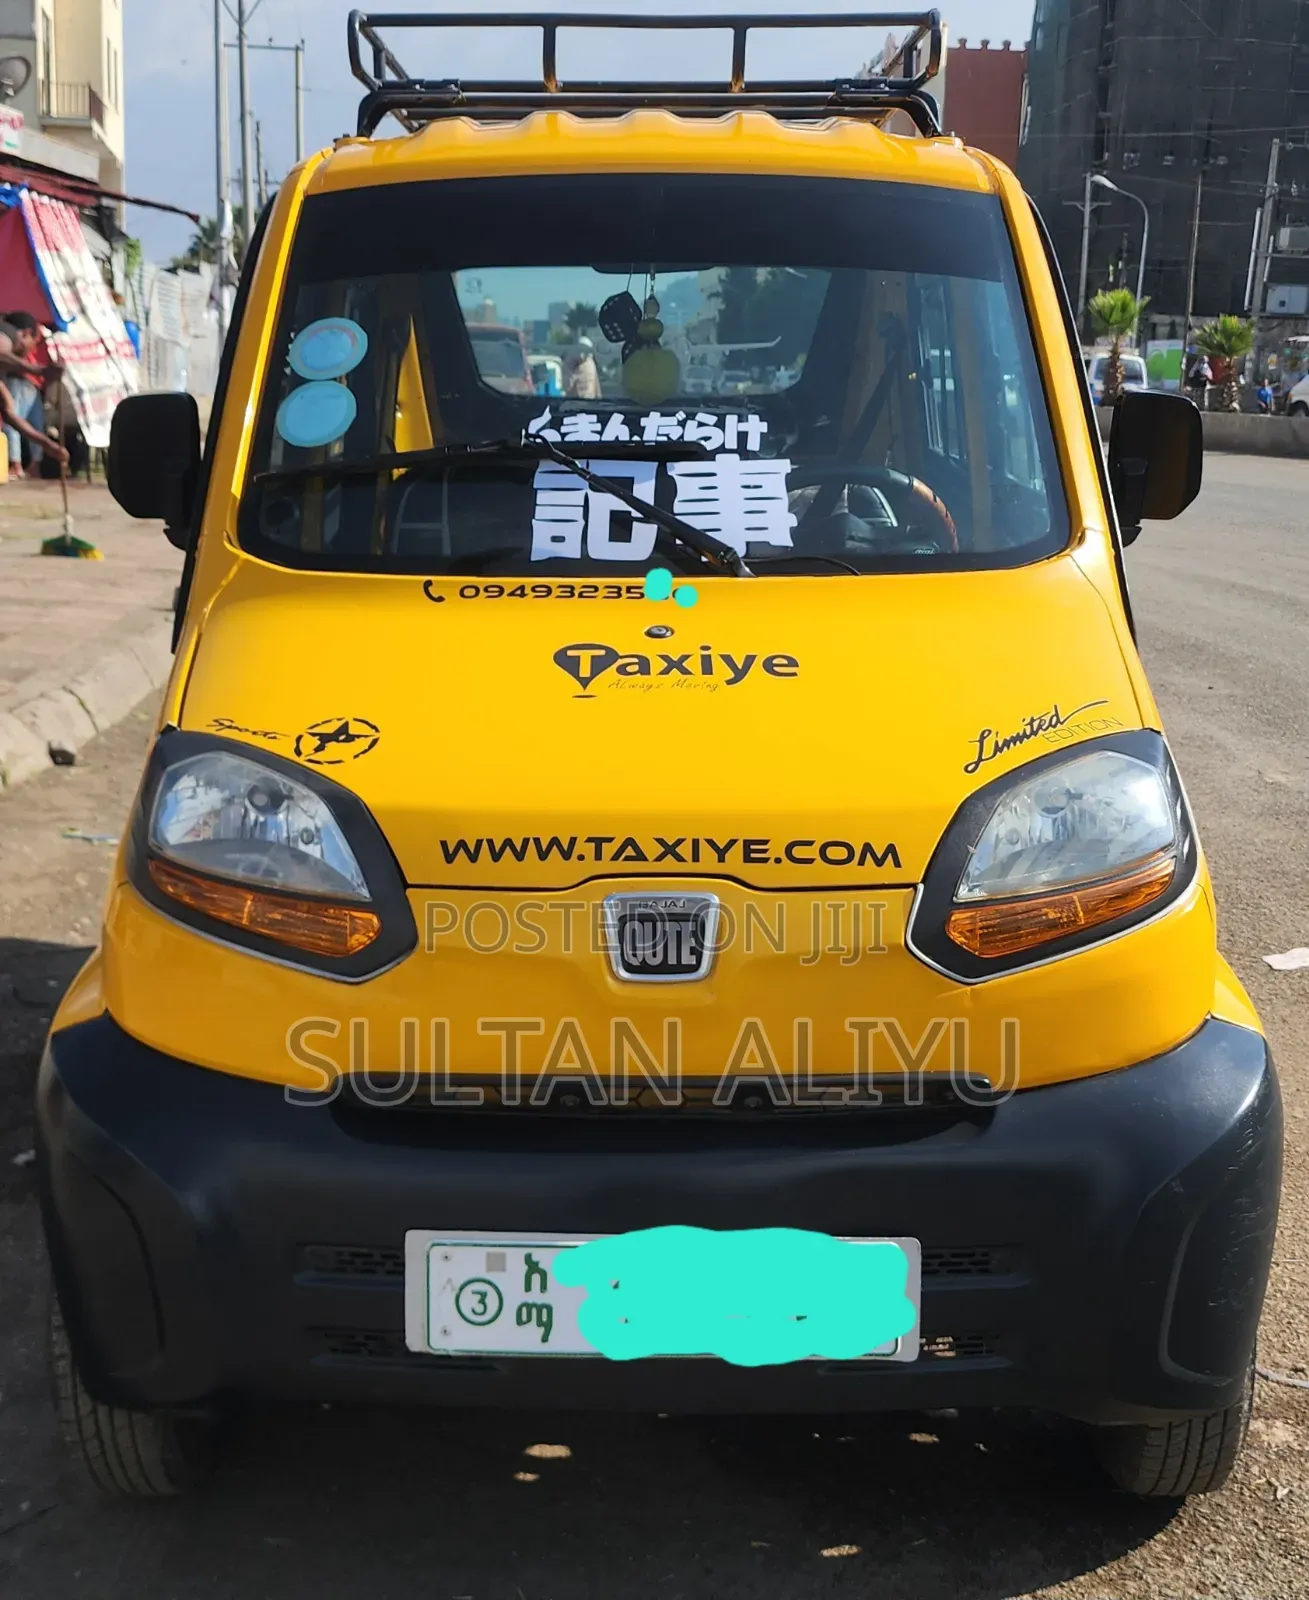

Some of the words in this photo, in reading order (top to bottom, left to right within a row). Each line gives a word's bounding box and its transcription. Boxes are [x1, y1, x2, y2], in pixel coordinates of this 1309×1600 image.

[530, 453, 798, 562] 記事
[458, 584, 697, 602] 09493235
[554, 643, 800, 688] Taxiye
[963, 700, 1109, 774] Limited
[1041, 716, 1124, 744] EDITION
[439, 836, 902, 869] WWW.TAXIYE.COM
[638, 899, 687, 909] BAJAJ
[623, 920, 697, 967] QUTE
